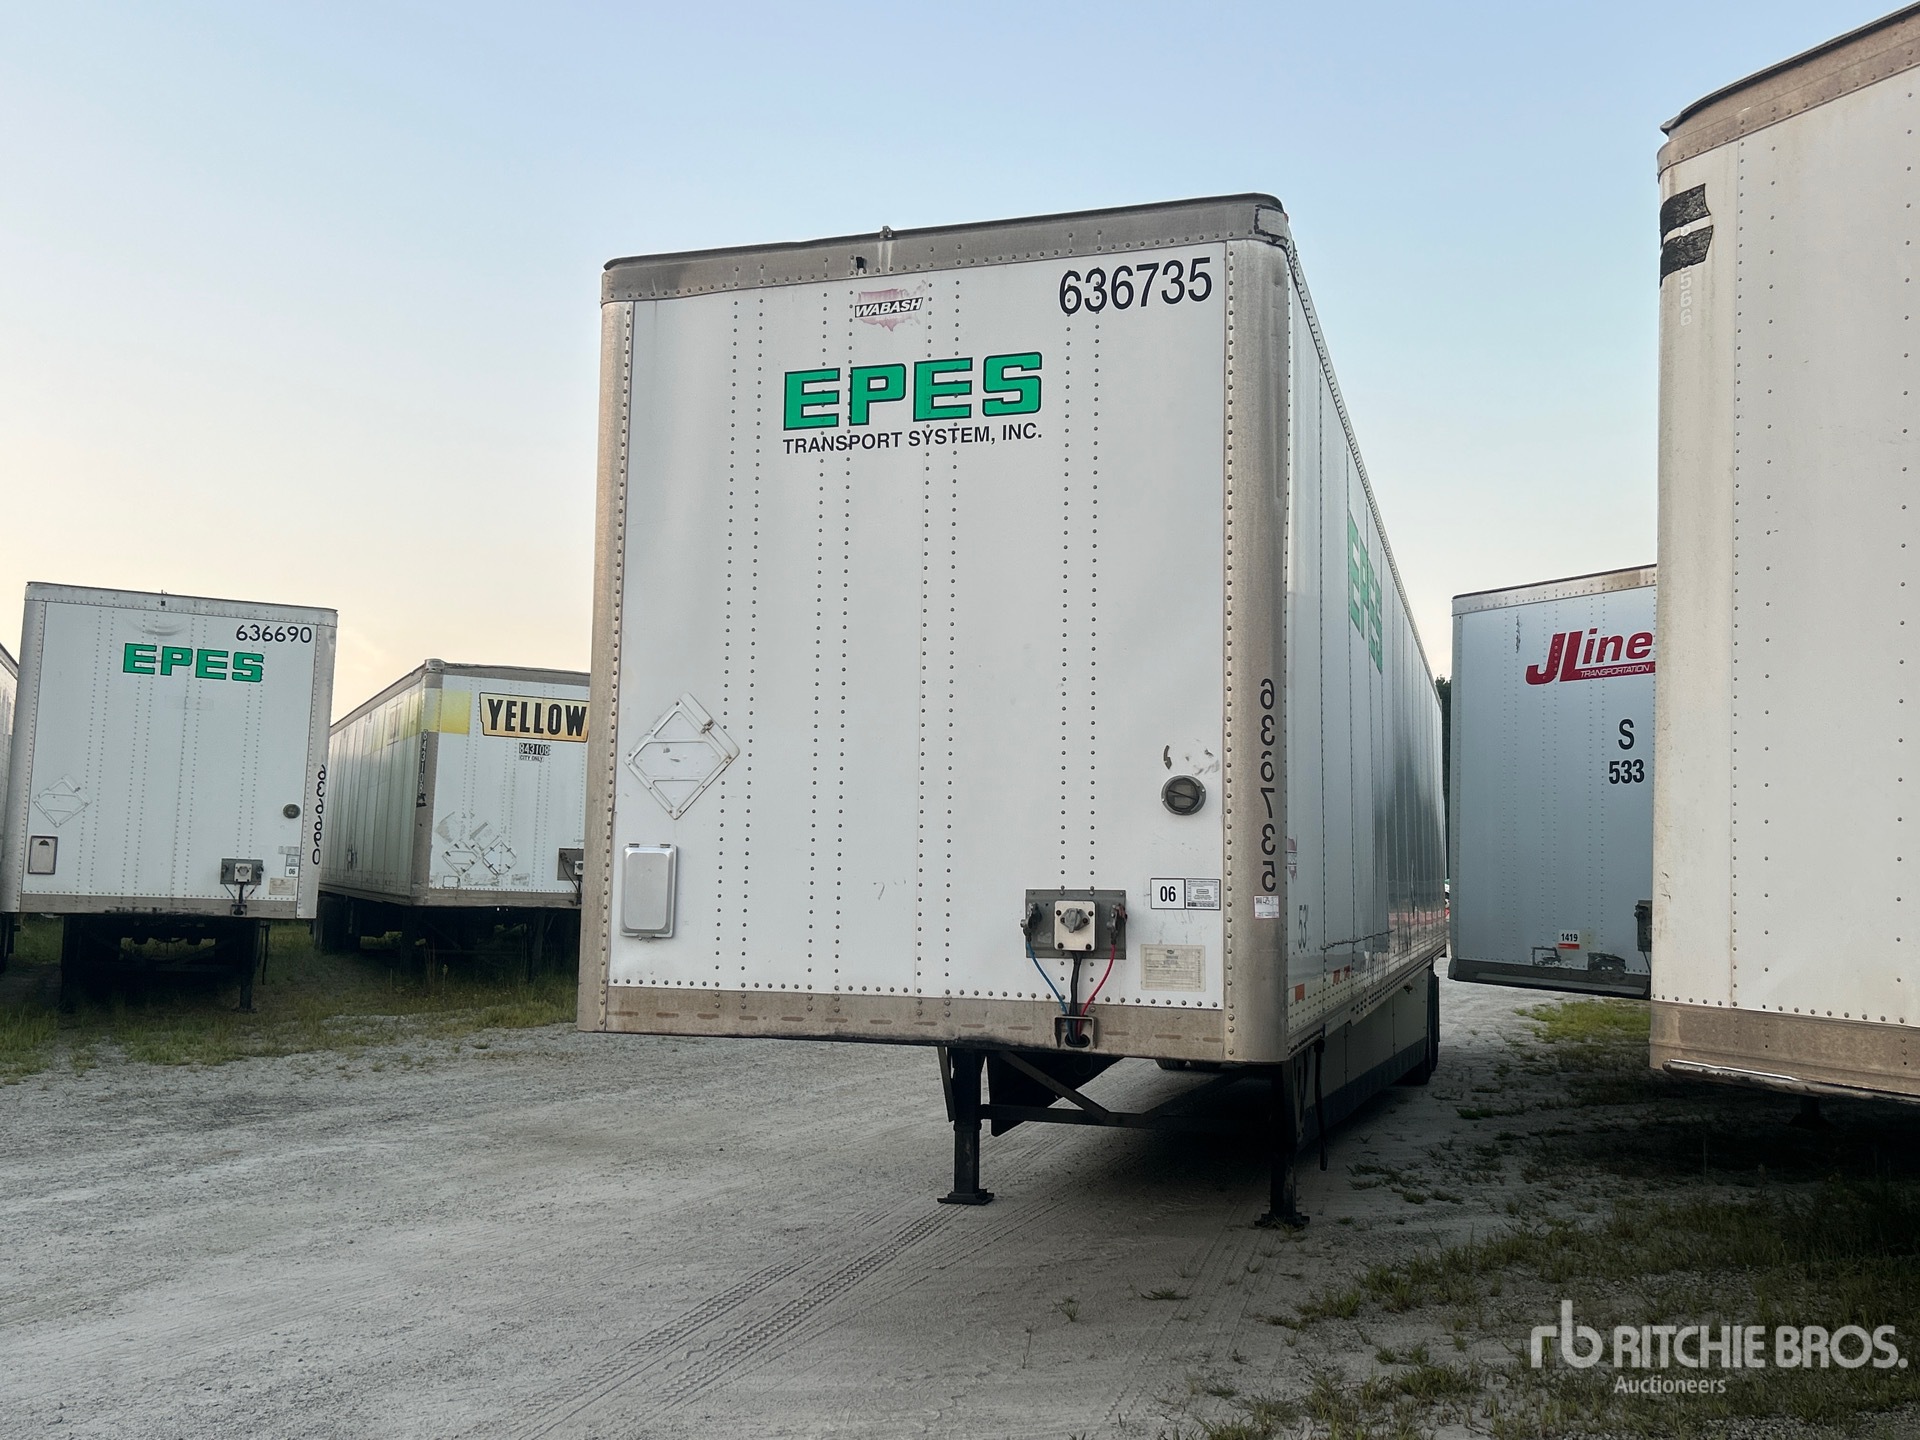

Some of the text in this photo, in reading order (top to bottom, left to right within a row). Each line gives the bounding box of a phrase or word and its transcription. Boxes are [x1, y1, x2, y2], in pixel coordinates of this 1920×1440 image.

[1059, 257, 1213, 315] 636735
[855, 297, 923, 318] WABASH
[783, 352, 1042, 431] EPES
[782, 422, 1043, 455] TRANSPORT SYSTEM, INC.
[1349, 511, 1382, 675] EPES
[236, 624, 312, 643] 636690
[122, 643, 265, 683] EPES
[1580, 663, 1650, 678] TRANSPORTATION
[487, 698, 587, 737] YELLOW
[519, 742, 550, 757] 843108
[1618, 718, 1635, 751] S
[1608, 758, 1645, 785] 533
[1159, 885, 1177, 903] 06
[1561, 932, 1578, 942] 1419
